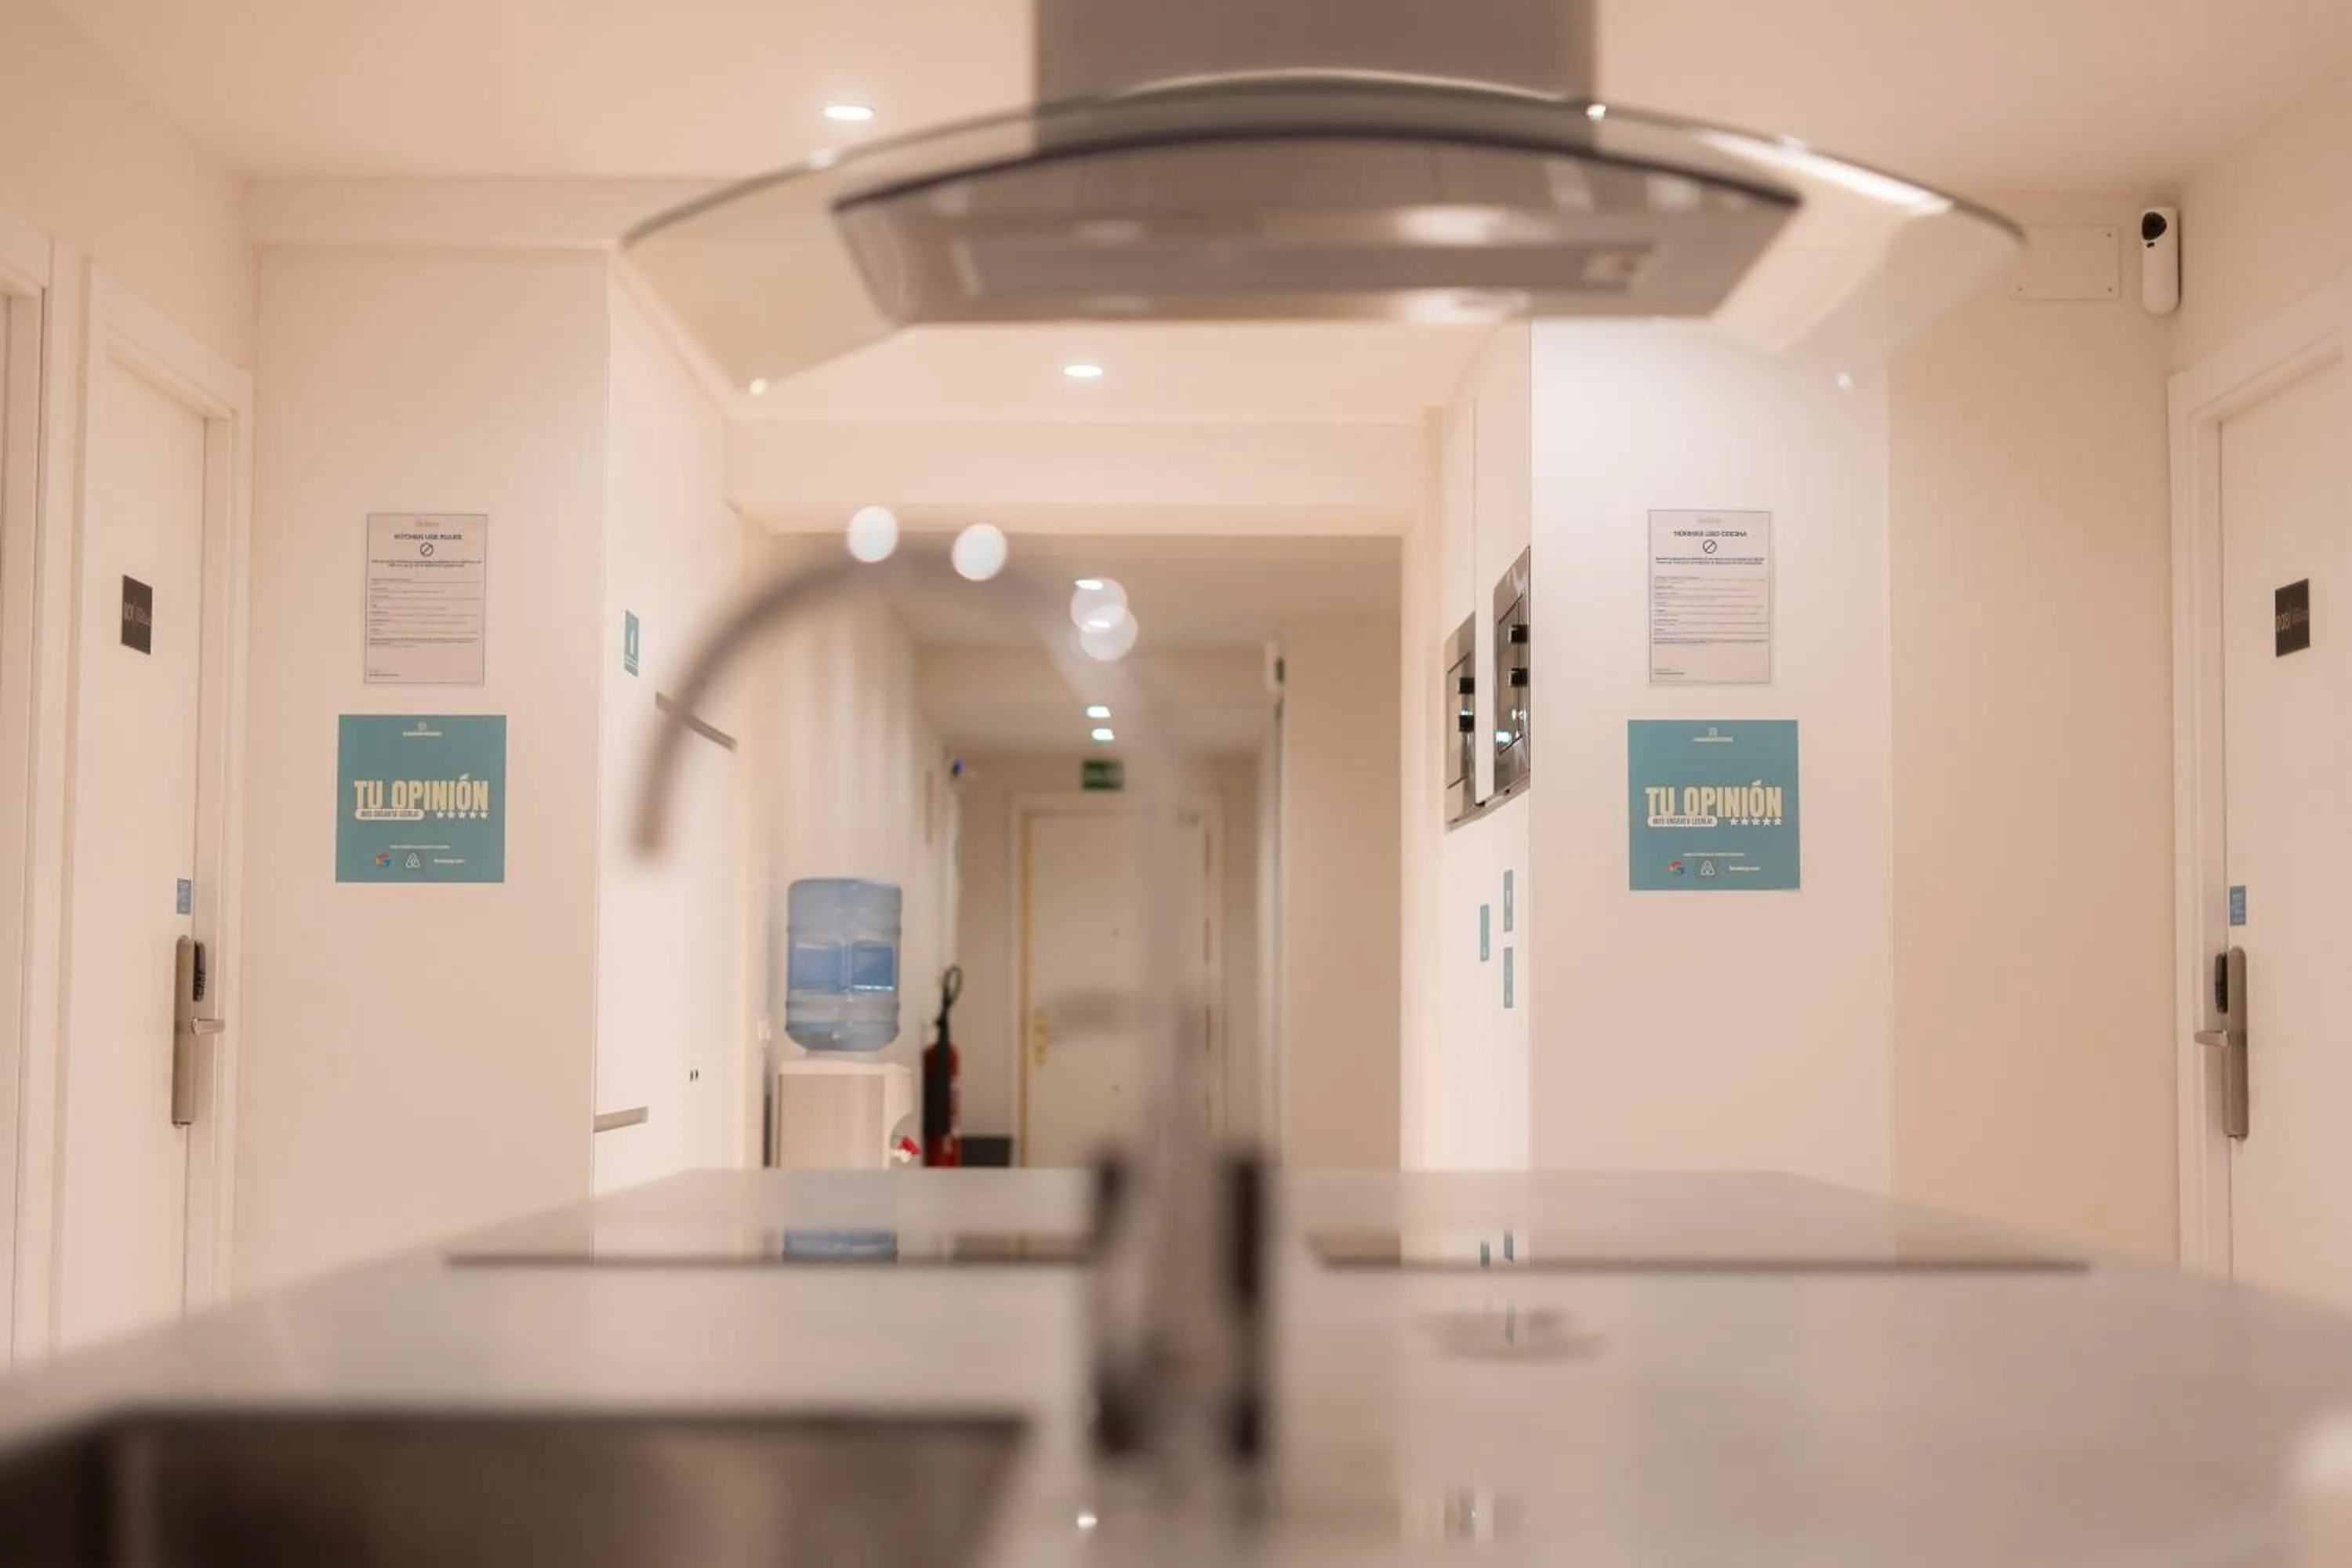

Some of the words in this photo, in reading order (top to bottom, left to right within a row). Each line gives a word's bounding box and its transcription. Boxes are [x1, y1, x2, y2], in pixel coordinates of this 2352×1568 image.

[354, 779, 383, 810] TU
[391, 773, 489, 811] OPINIÓN
[1645, 786, 1675, 816] TU
[1683, 779, 1782, 818] OPINIÓN
